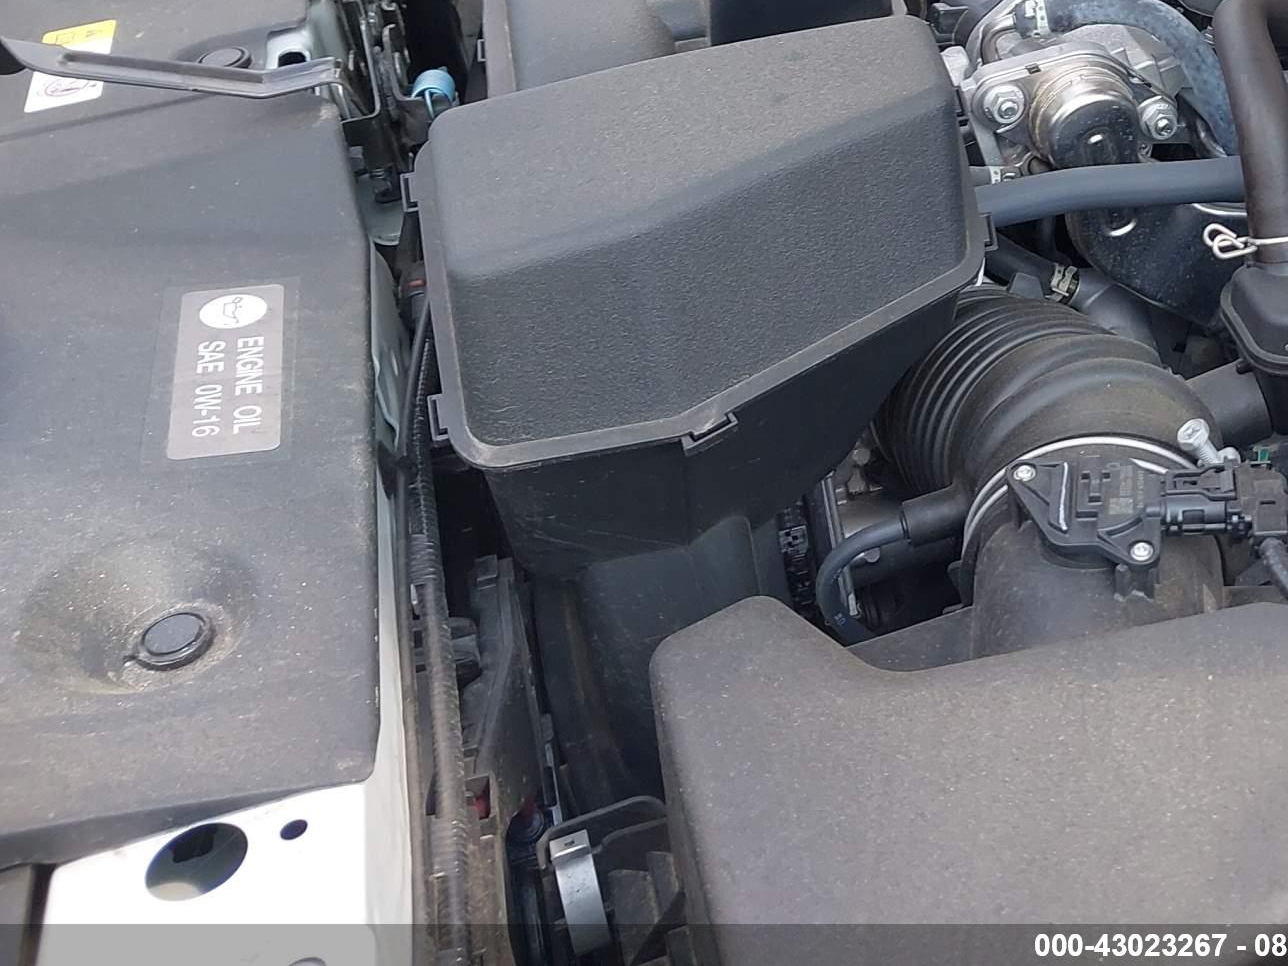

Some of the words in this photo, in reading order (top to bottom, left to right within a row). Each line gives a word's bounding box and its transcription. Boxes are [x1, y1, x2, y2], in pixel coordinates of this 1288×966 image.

[196, 340, 226, 374] SAE
[235, 336, 265, 396] ENGINE
[191, 384, 223, 438] 0W-16
[232, 405, 262, 435] OIL
